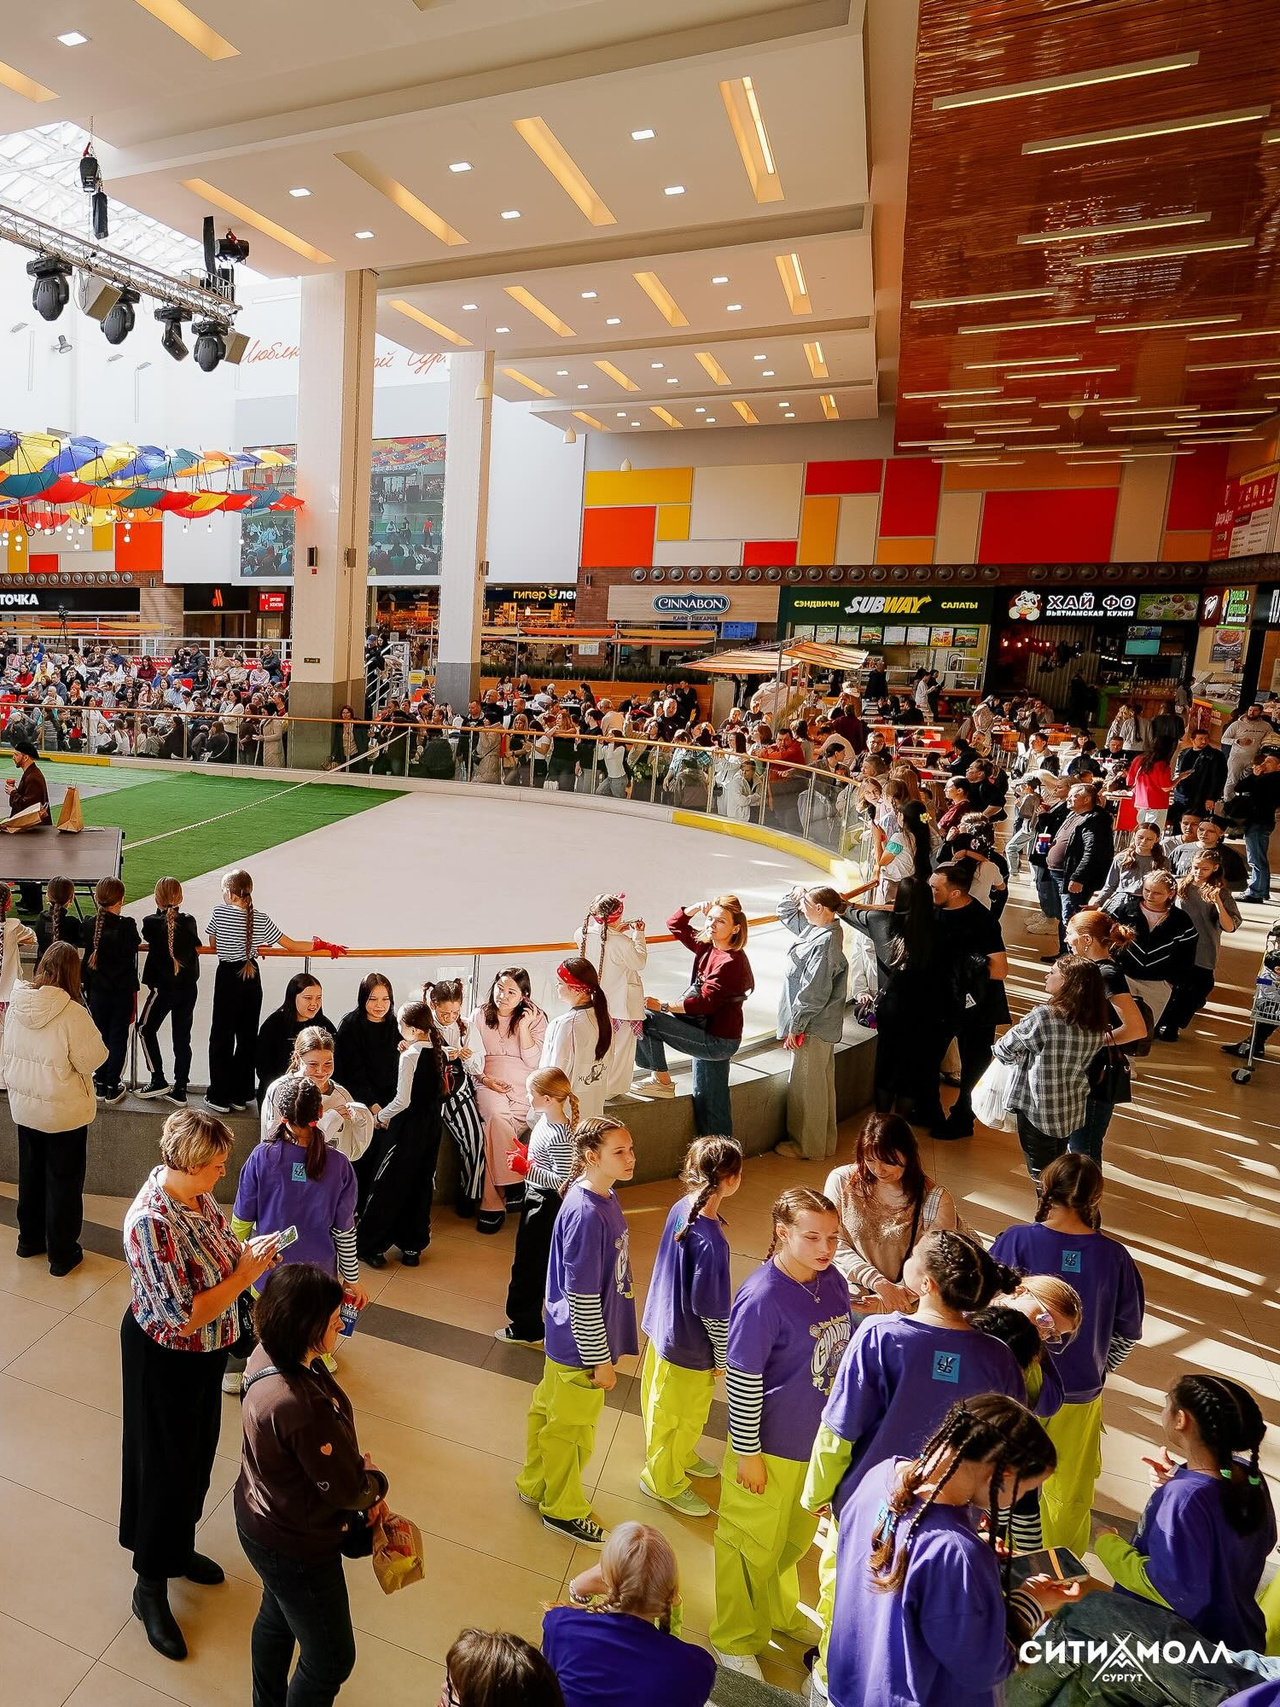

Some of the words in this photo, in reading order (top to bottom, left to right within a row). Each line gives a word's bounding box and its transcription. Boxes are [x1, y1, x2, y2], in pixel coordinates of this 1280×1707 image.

[407, 351, 447, 375] Сур
[513, 591, 547, 601] гипер
[1047, 592, 1095, 610] ХАЙ
[1102, 595, 1136, 610] ФО
[658, 597, 724, 609] CINNABON
[794, 600, 840, 608] СЭНДВИЧИ
[845, 595, 932, 614] SUBWAY
[941, 601, 979, 609] САЛАТЫ
